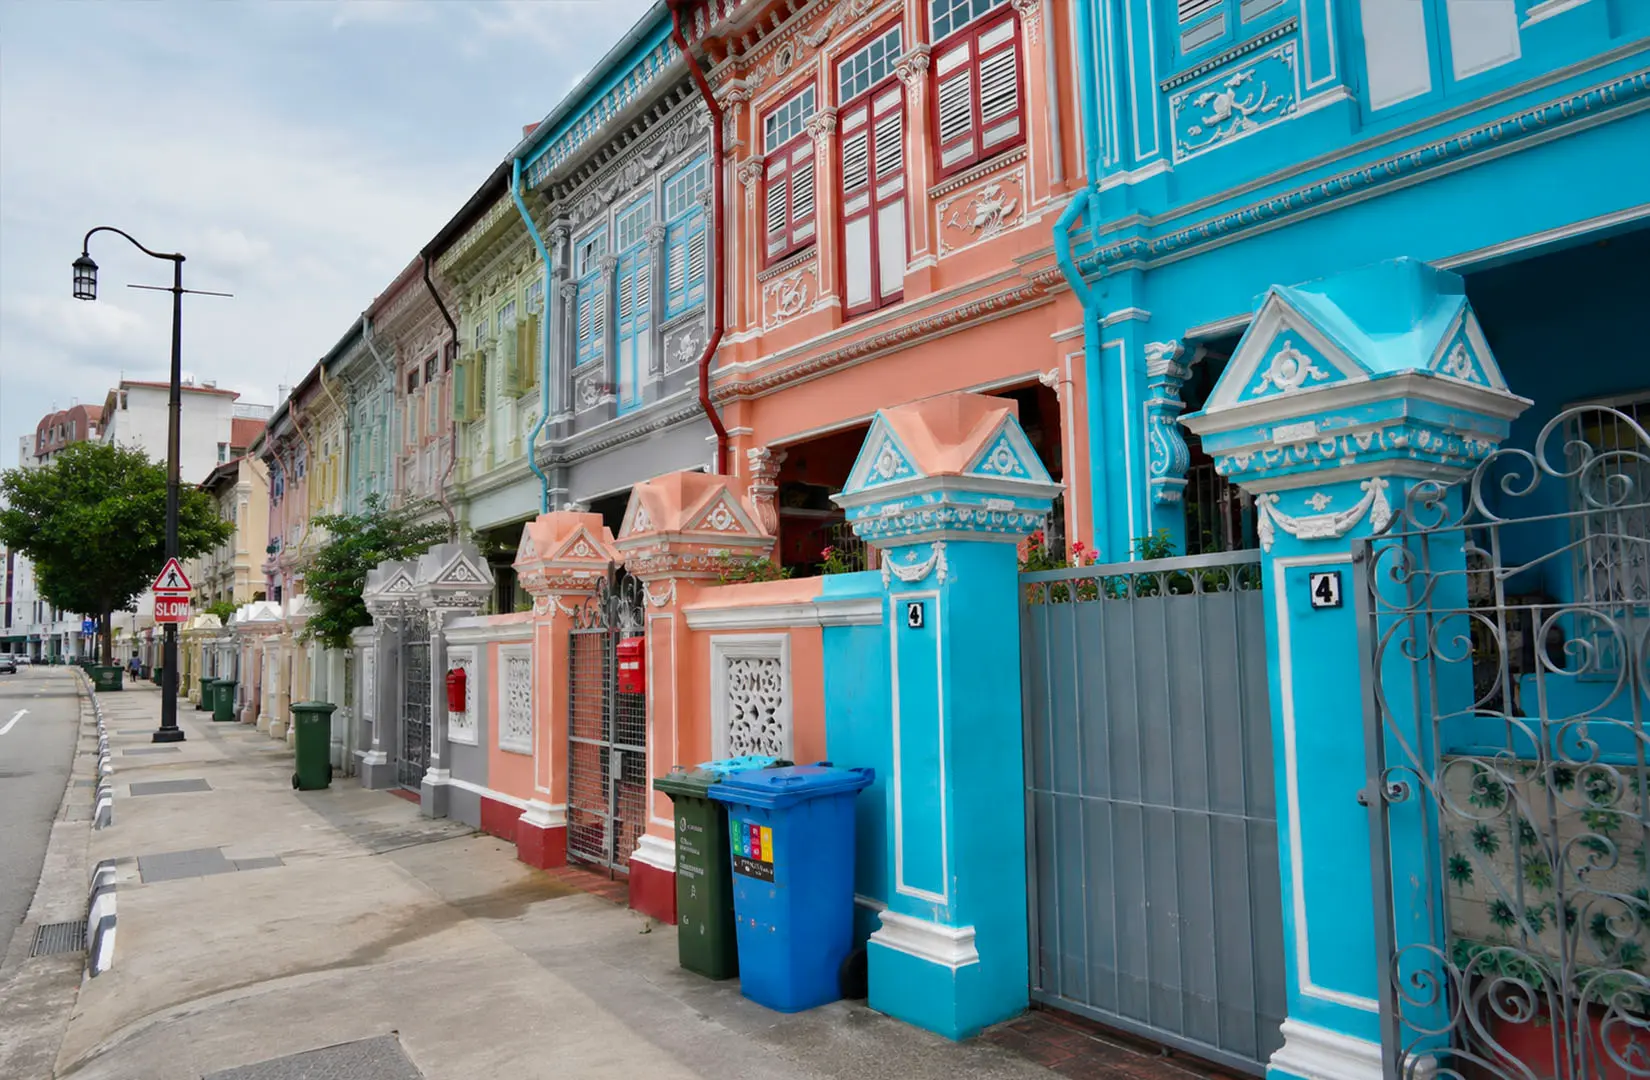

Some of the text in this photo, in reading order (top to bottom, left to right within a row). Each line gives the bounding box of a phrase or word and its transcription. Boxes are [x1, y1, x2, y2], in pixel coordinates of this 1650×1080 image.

[1315, 576, 1333, 603] 4
[156, 602, 188, 617] SLOW
[910, 605, 920, 624] 4
